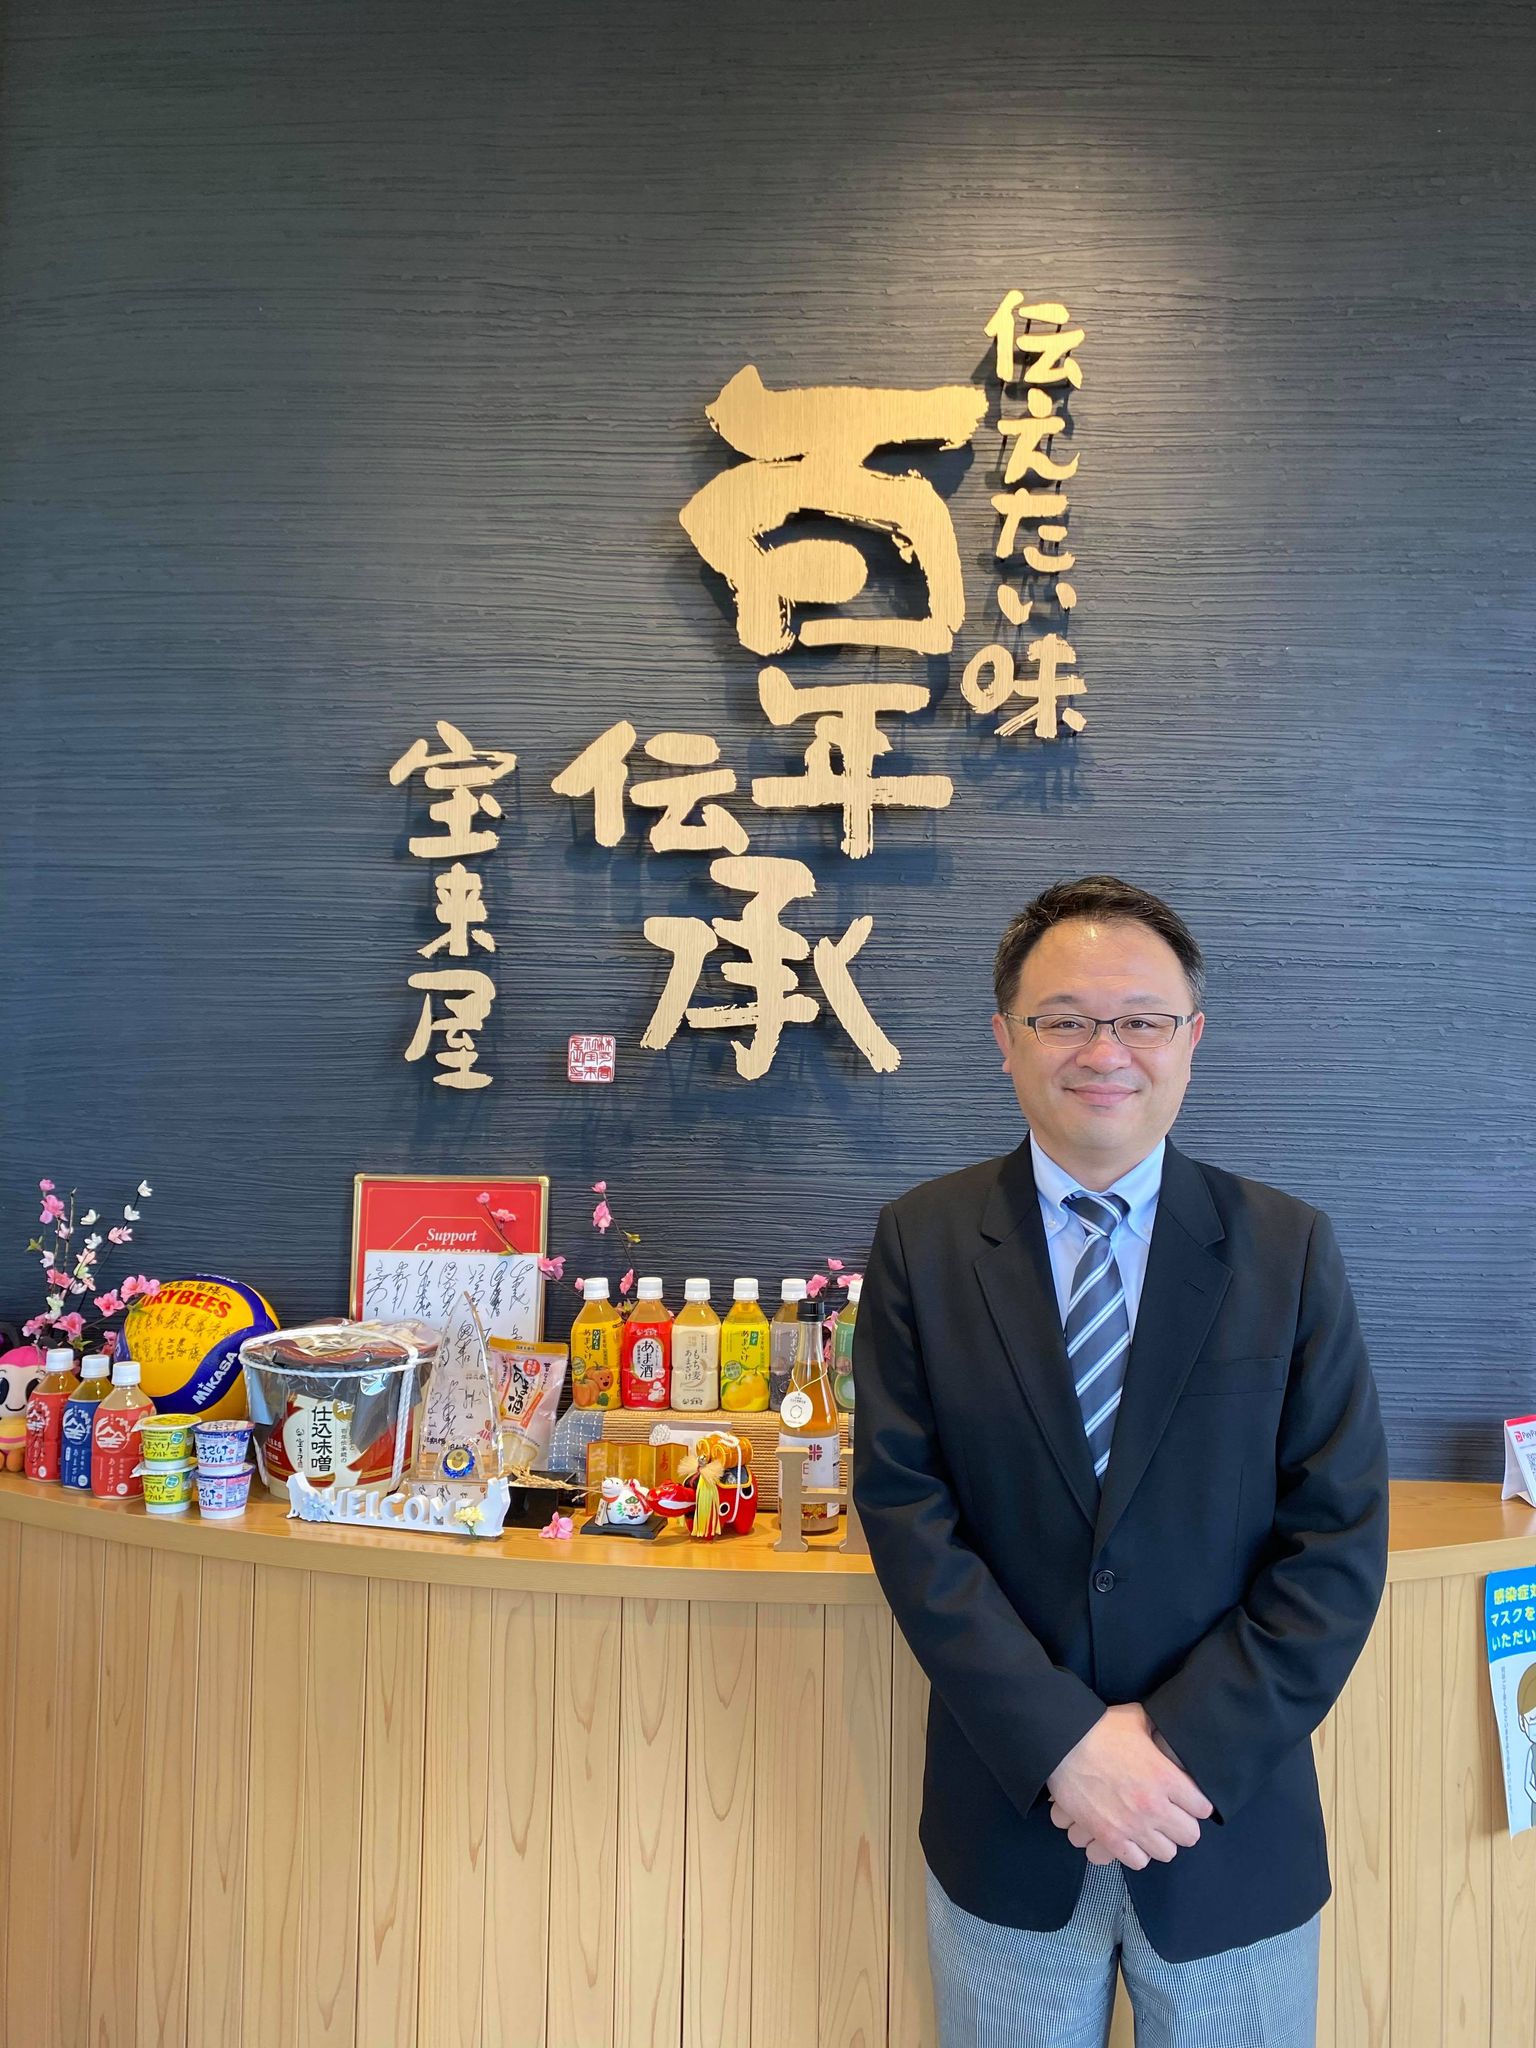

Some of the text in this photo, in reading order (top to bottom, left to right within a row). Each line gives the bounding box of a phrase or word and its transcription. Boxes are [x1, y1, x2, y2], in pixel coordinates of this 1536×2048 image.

[961, 289, 1088, 739] 伝えたい味
[679, 364, 989, 860] 百年
[390, 720, 517, 1091] 宝来屋
[551, 720, 901, 1081] 伝承
[426, 1227, 478, 1245] Support
[640, 1340, 654, 1378] あま酒
[684, 1350, 692, 1380] あまざけ
[693, 1350, 701, 1380] もち麦
[311, 1406, 333, 1472] 仕込味噌
[1491, 1606, 1536, 1627] マスクを
